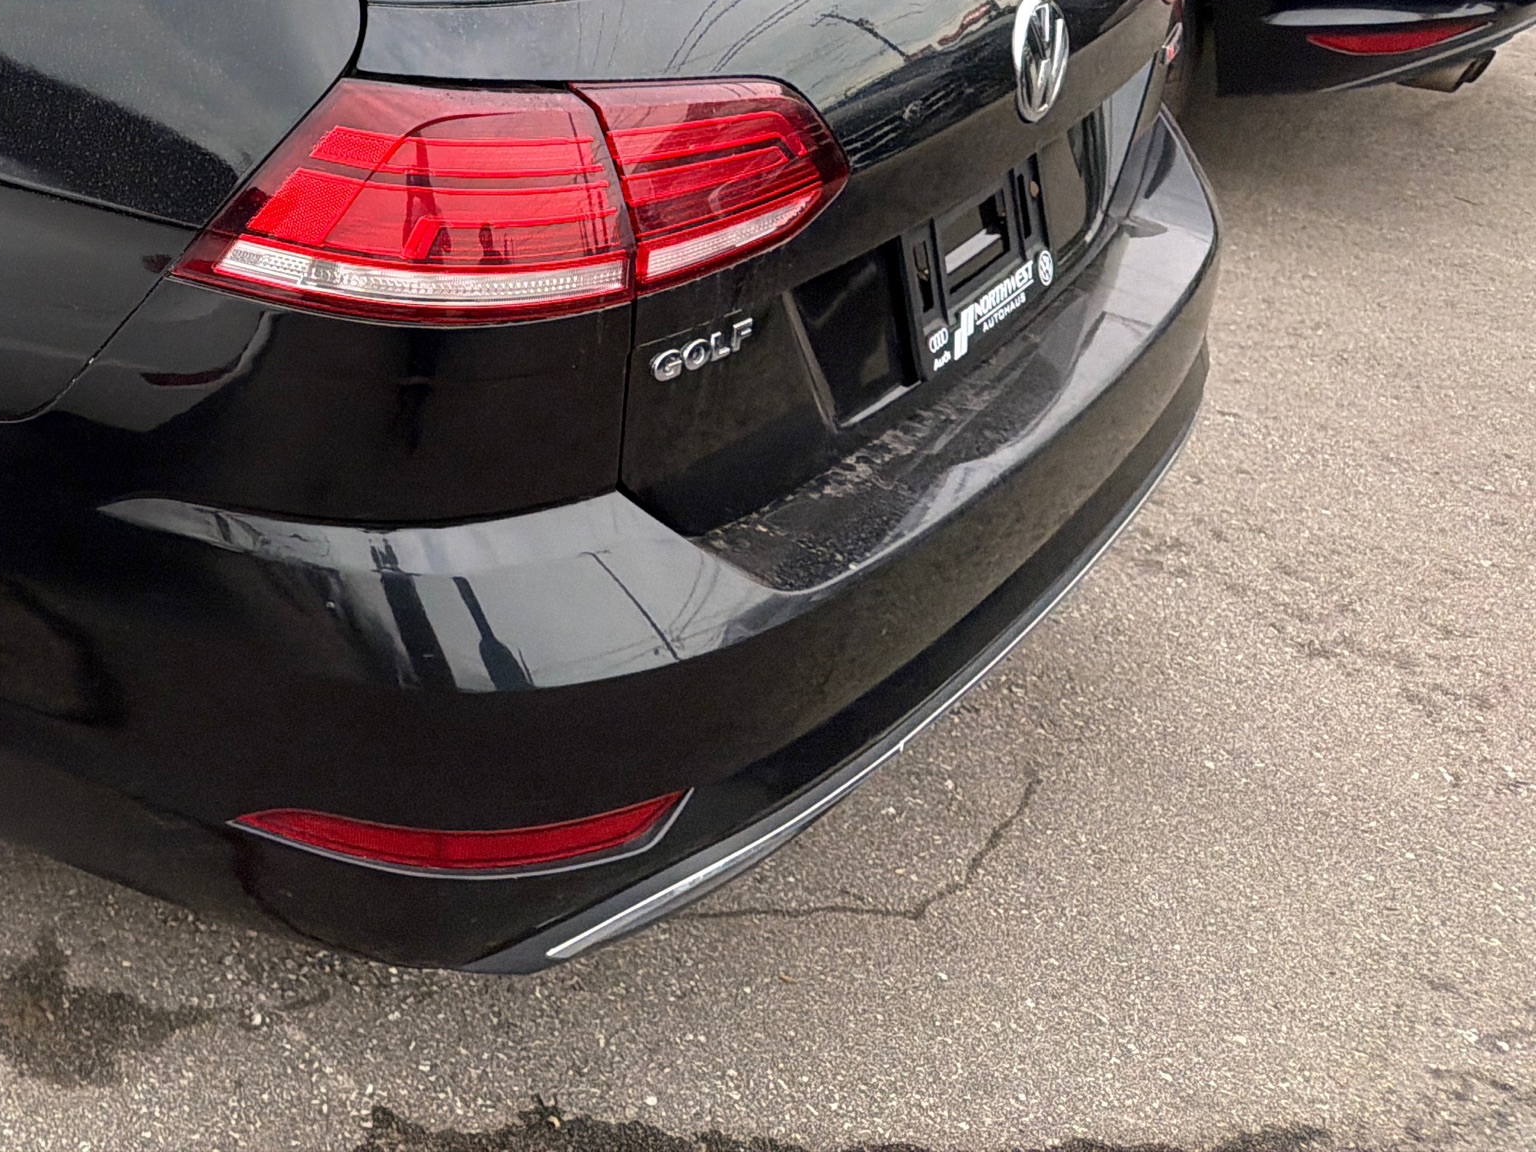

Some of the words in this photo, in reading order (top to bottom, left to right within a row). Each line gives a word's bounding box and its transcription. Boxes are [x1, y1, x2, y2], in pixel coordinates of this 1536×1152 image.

[974, 260, 1033, 321] NORTHWEST
[982, 292, 1027, 333] AUTOHAUS
[649, 317, 753, 382] GOLF
[933, 350, 951, 371] Audi
